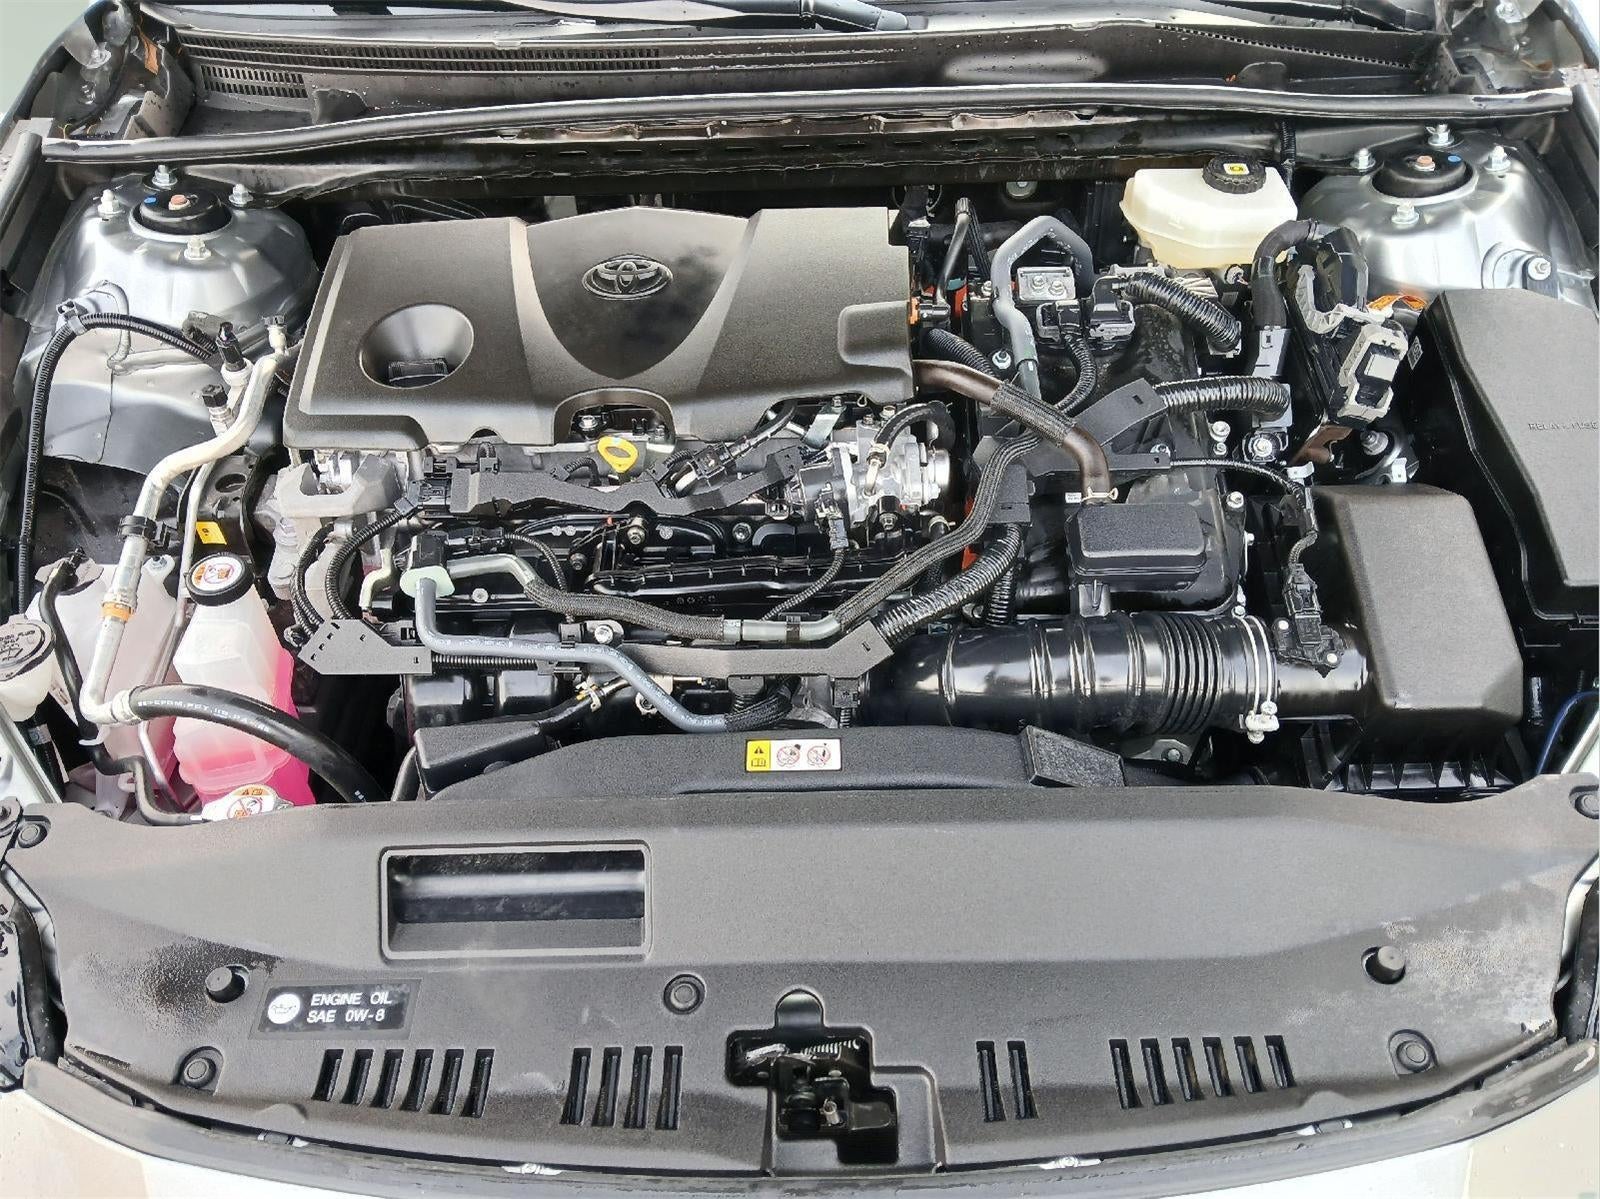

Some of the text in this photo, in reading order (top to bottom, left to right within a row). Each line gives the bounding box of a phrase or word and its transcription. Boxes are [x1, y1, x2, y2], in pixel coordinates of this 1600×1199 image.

[310, 991, 393, 1007] ENGINE OIL
[306, 1008, 386, 1023] SAE 0W-8
